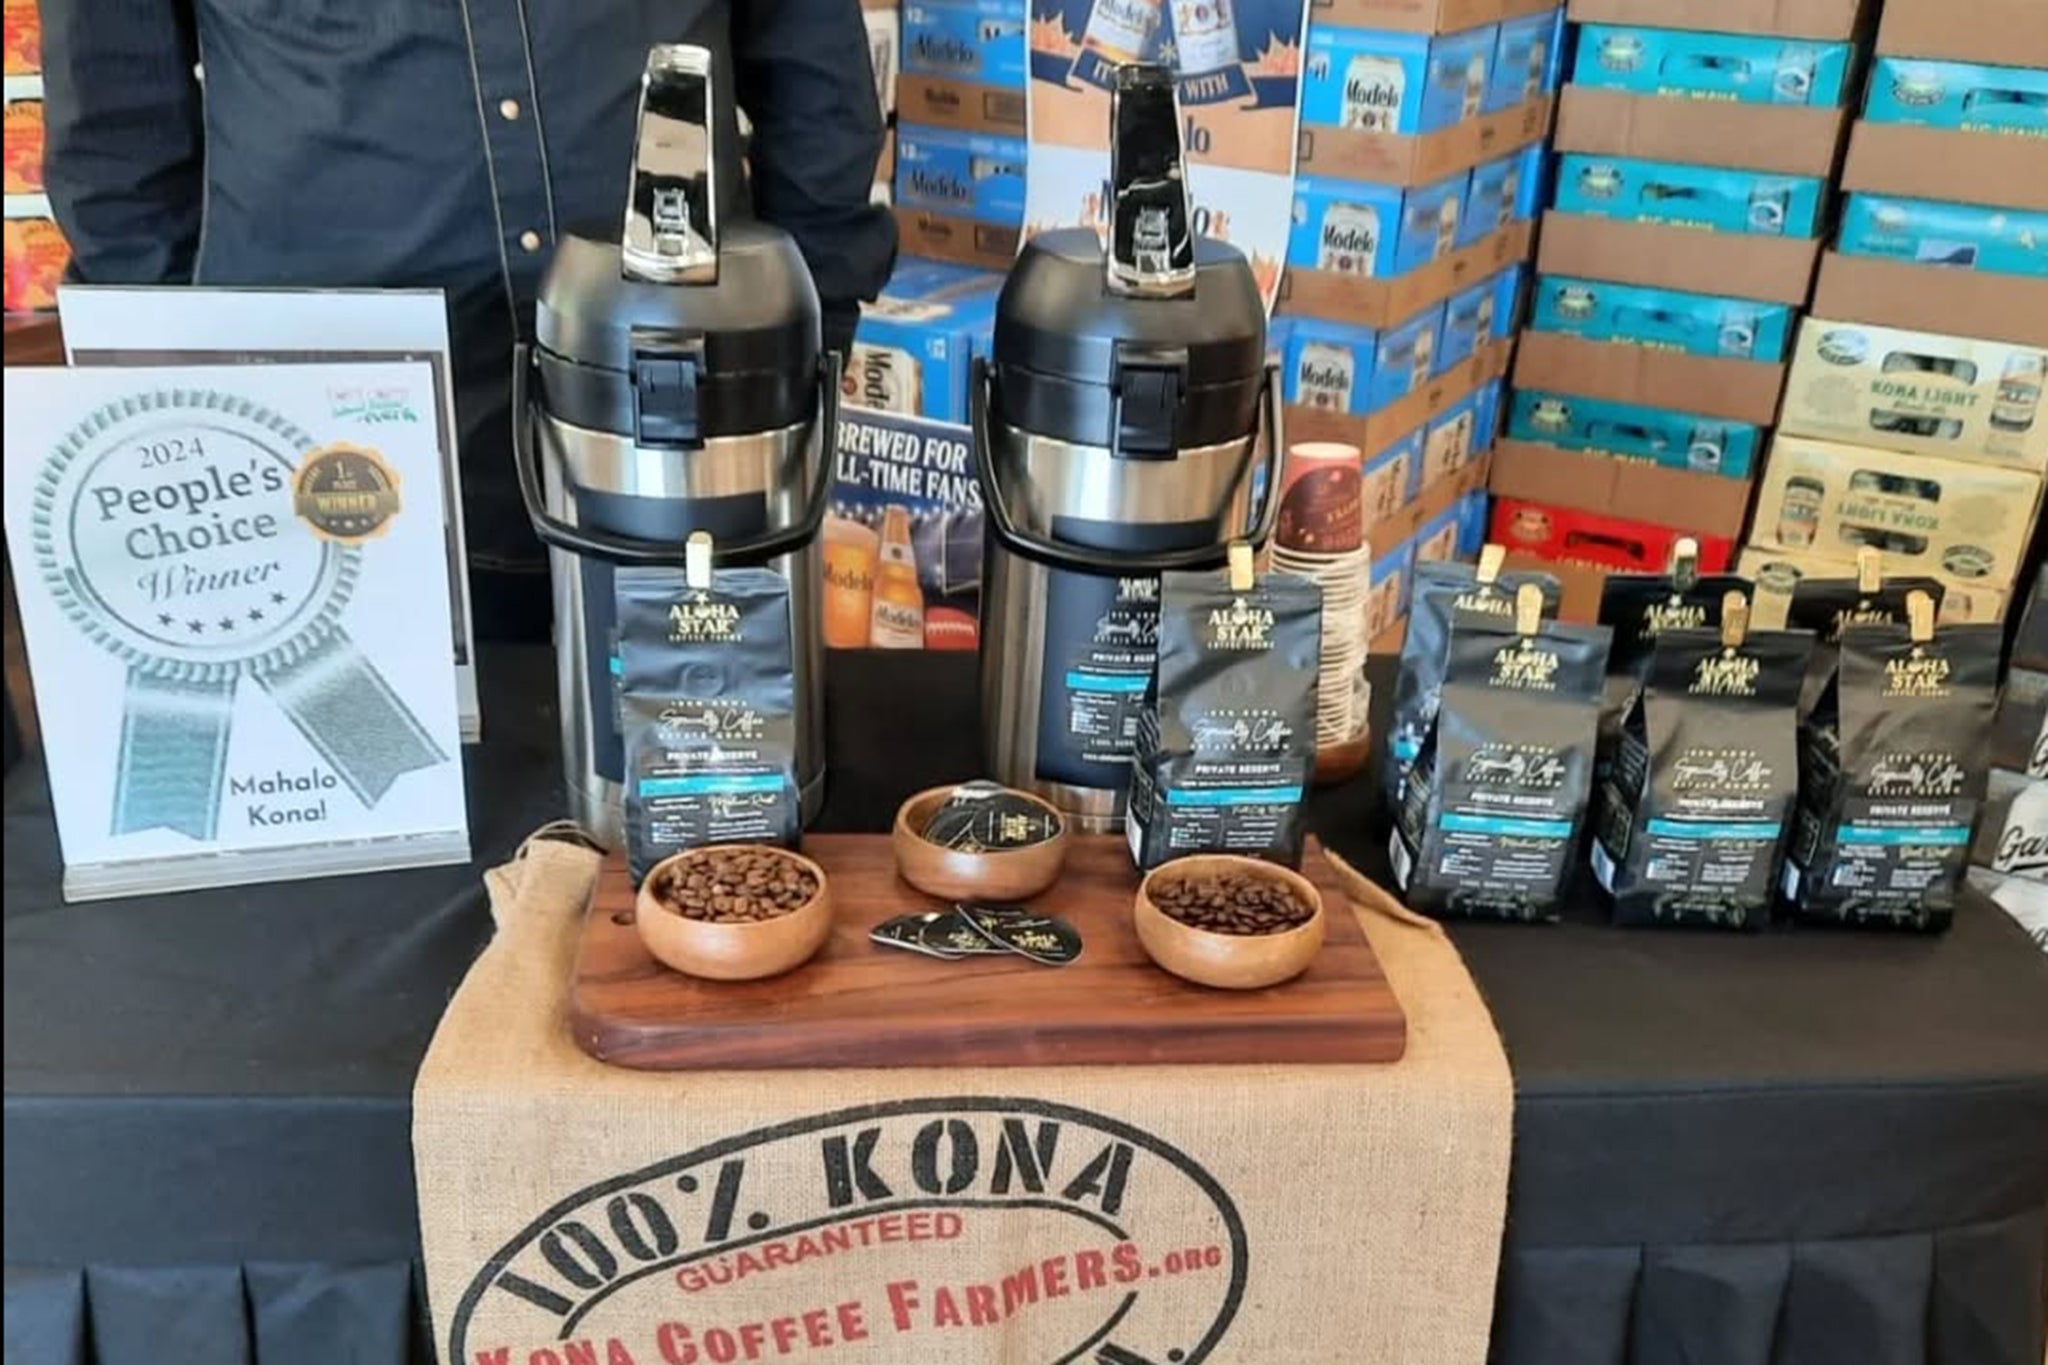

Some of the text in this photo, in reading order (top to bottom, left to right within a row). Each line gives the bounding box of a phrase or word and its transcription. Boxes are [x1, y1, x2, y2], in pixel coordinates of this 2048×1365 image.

[1185, 74, 1229, 100] WITH
[1346, 80, 1399, 108] Modelo
[911, 168, 967, 199] Modelo
[1323, 222, 1375, 254] Modelo
[864, 353, 892, 409] Mode
[1300, 362, 1350, 392] Modelo
[1870, 380, 1979, 407] KONA LIGHT
[135, 436, 206, 470] 2024
[923, 437, 967, 474] FOR
[92, 458, 284, 522] People's
[836, 453, 983, 509] LL-TIME FANS
[124, 512, 278, 562] Choice
[137, 560, 284, 603] Winner
[668, 603, 741, 621] ALOHA
[1208, 608, 1275, 626] ALOHA
[1453, 594, 1513, 617] ALOHA
[1644, 603, 1705, 621] ALOHA
[1832, 609, 1893, 627] ALOHA
[678, 618, 736, 634] STAR
[1217, 625, 1270, 642] STAR
[1493, 648, 1558, 670] ALOHA
[1500, 664, 1552, 681] STAR
[1695, 656, 1759, 675] ALOHA
[1884, 658, 1950, 676] ALOHA
[1891, 673, 1948, 689] STAR
[229, 764, 338, 797] Mahalo
[1195, 763, 1280, 775] PRIVATE RESERVE
[1470, 792, 1511, 804] PRIVATE
[1869, 803, 1951, 816] PRIVATE RESERVE
[248, 801, 328, 828] Kona!
[1997, 825, 2048, 862] Ga
[494, 1117, 1136, 1317] 100% KONA
[673, 1212, 964, 1293] GUARANTEED
[654, 1299, 870, 1365] COFFEE
